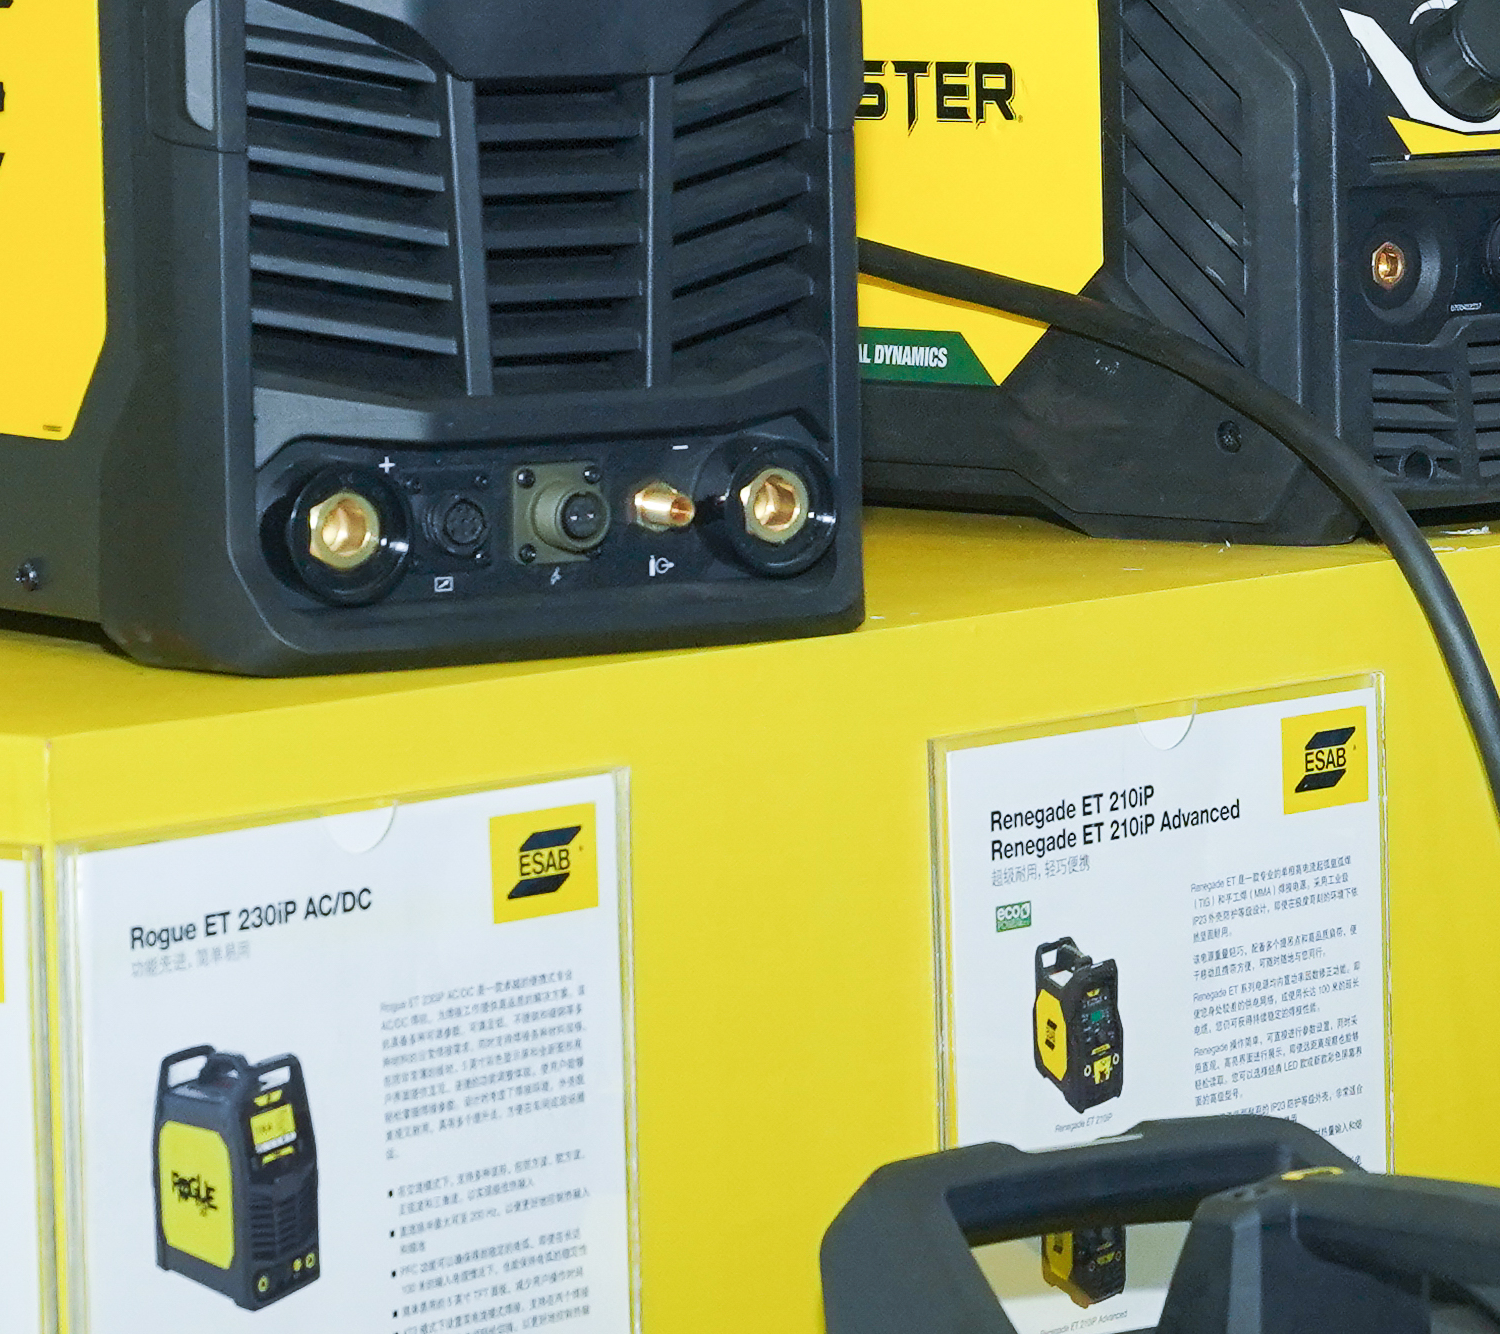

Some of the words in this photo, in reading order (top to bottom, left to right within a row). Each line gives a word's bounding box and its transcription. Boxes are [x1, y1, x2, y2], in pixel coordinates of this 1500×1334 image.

[874, 344, 949, 368] DYNAMICS
[1305, 746, 1348, 774] ESAB
[990, 799, 1077, 832] Renegade
[1082, 792, 1104, 817] ET
[1109, 784, 1155, 812] 210iP
[991, 828, 1077, 861] Renegade
[1083, 821, 1105, 846] ET
[1110, 813, 1155, 841] 210iP
[1159, 798, 1241, 833] Advanced
[518, 848, 572, 878] ESAB
[130, 923, 198, 953] Rogue
[203, 910, 232, 938] ET
[238, 898, 297, 932] 230iP
[303, 886, 374, 922] AC/DC
